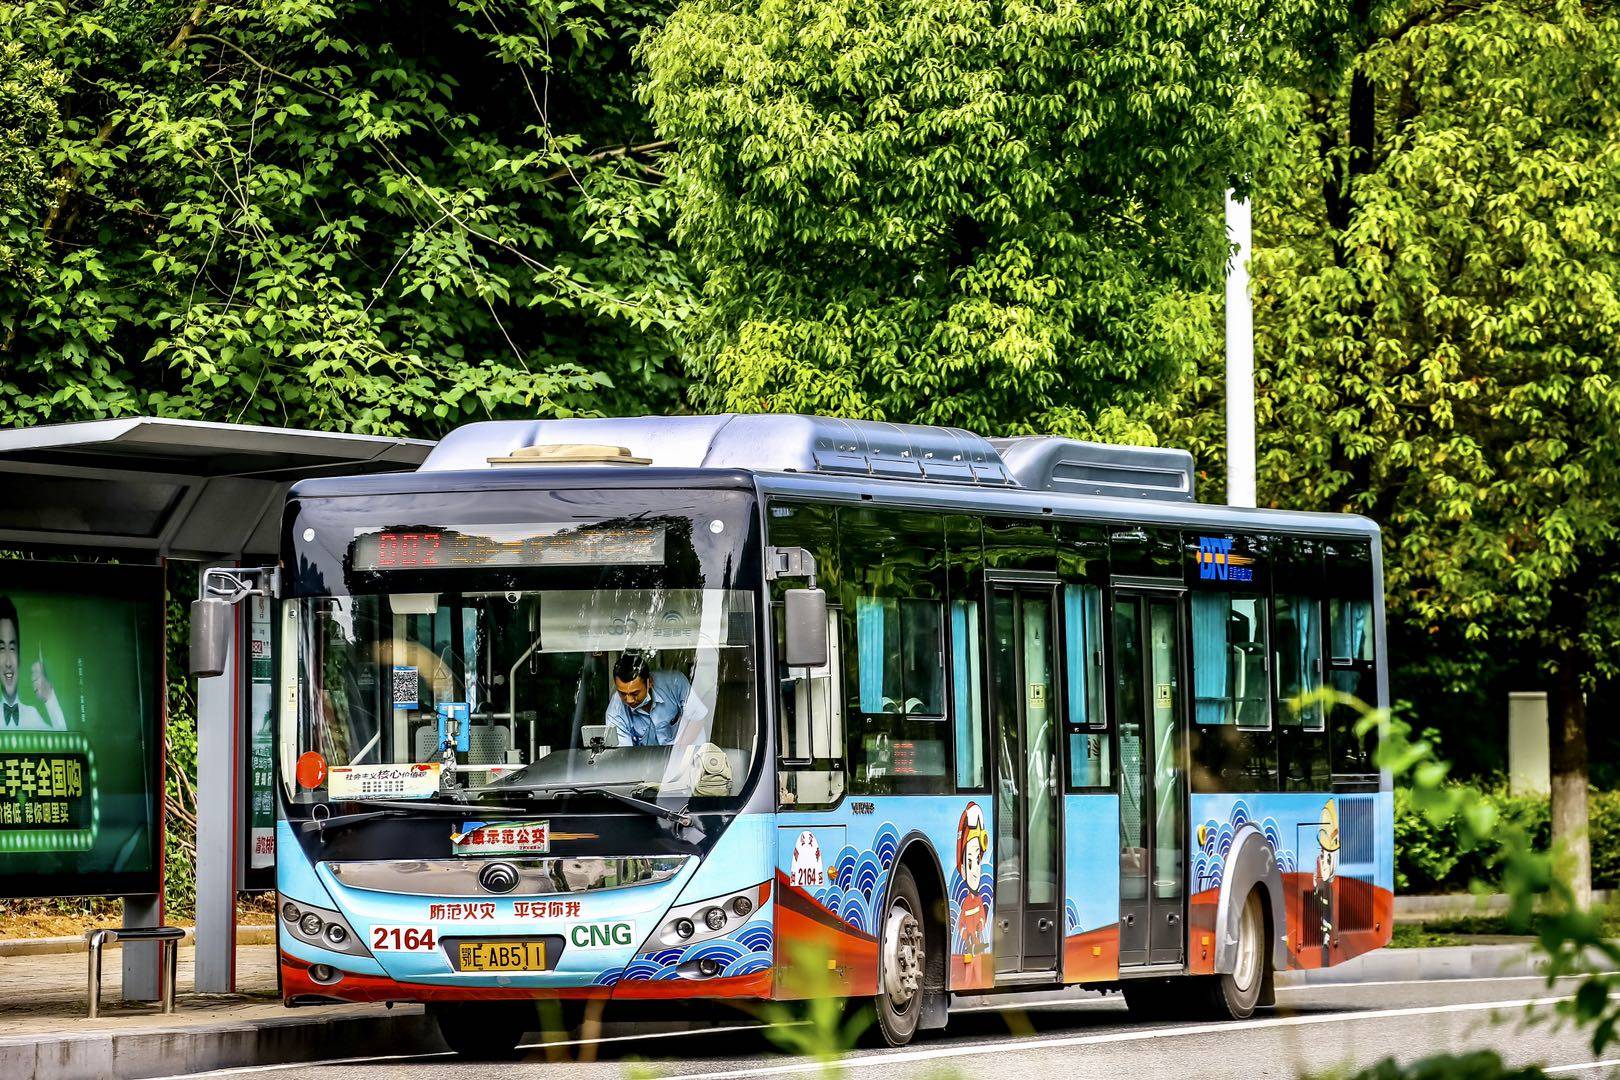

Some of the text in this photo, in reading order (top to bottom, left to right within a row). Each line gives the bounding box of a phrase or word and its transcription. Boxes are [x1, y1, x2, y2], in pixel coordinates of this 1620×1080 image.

[379, 534, 439, 565] 002
[798, 868, 816, 885] 2164
[430, 902, 580, 920] 防范火灾 平安你我
[374, 928, 436, 950] 2164
[572, 923, 632, 947] CNG
